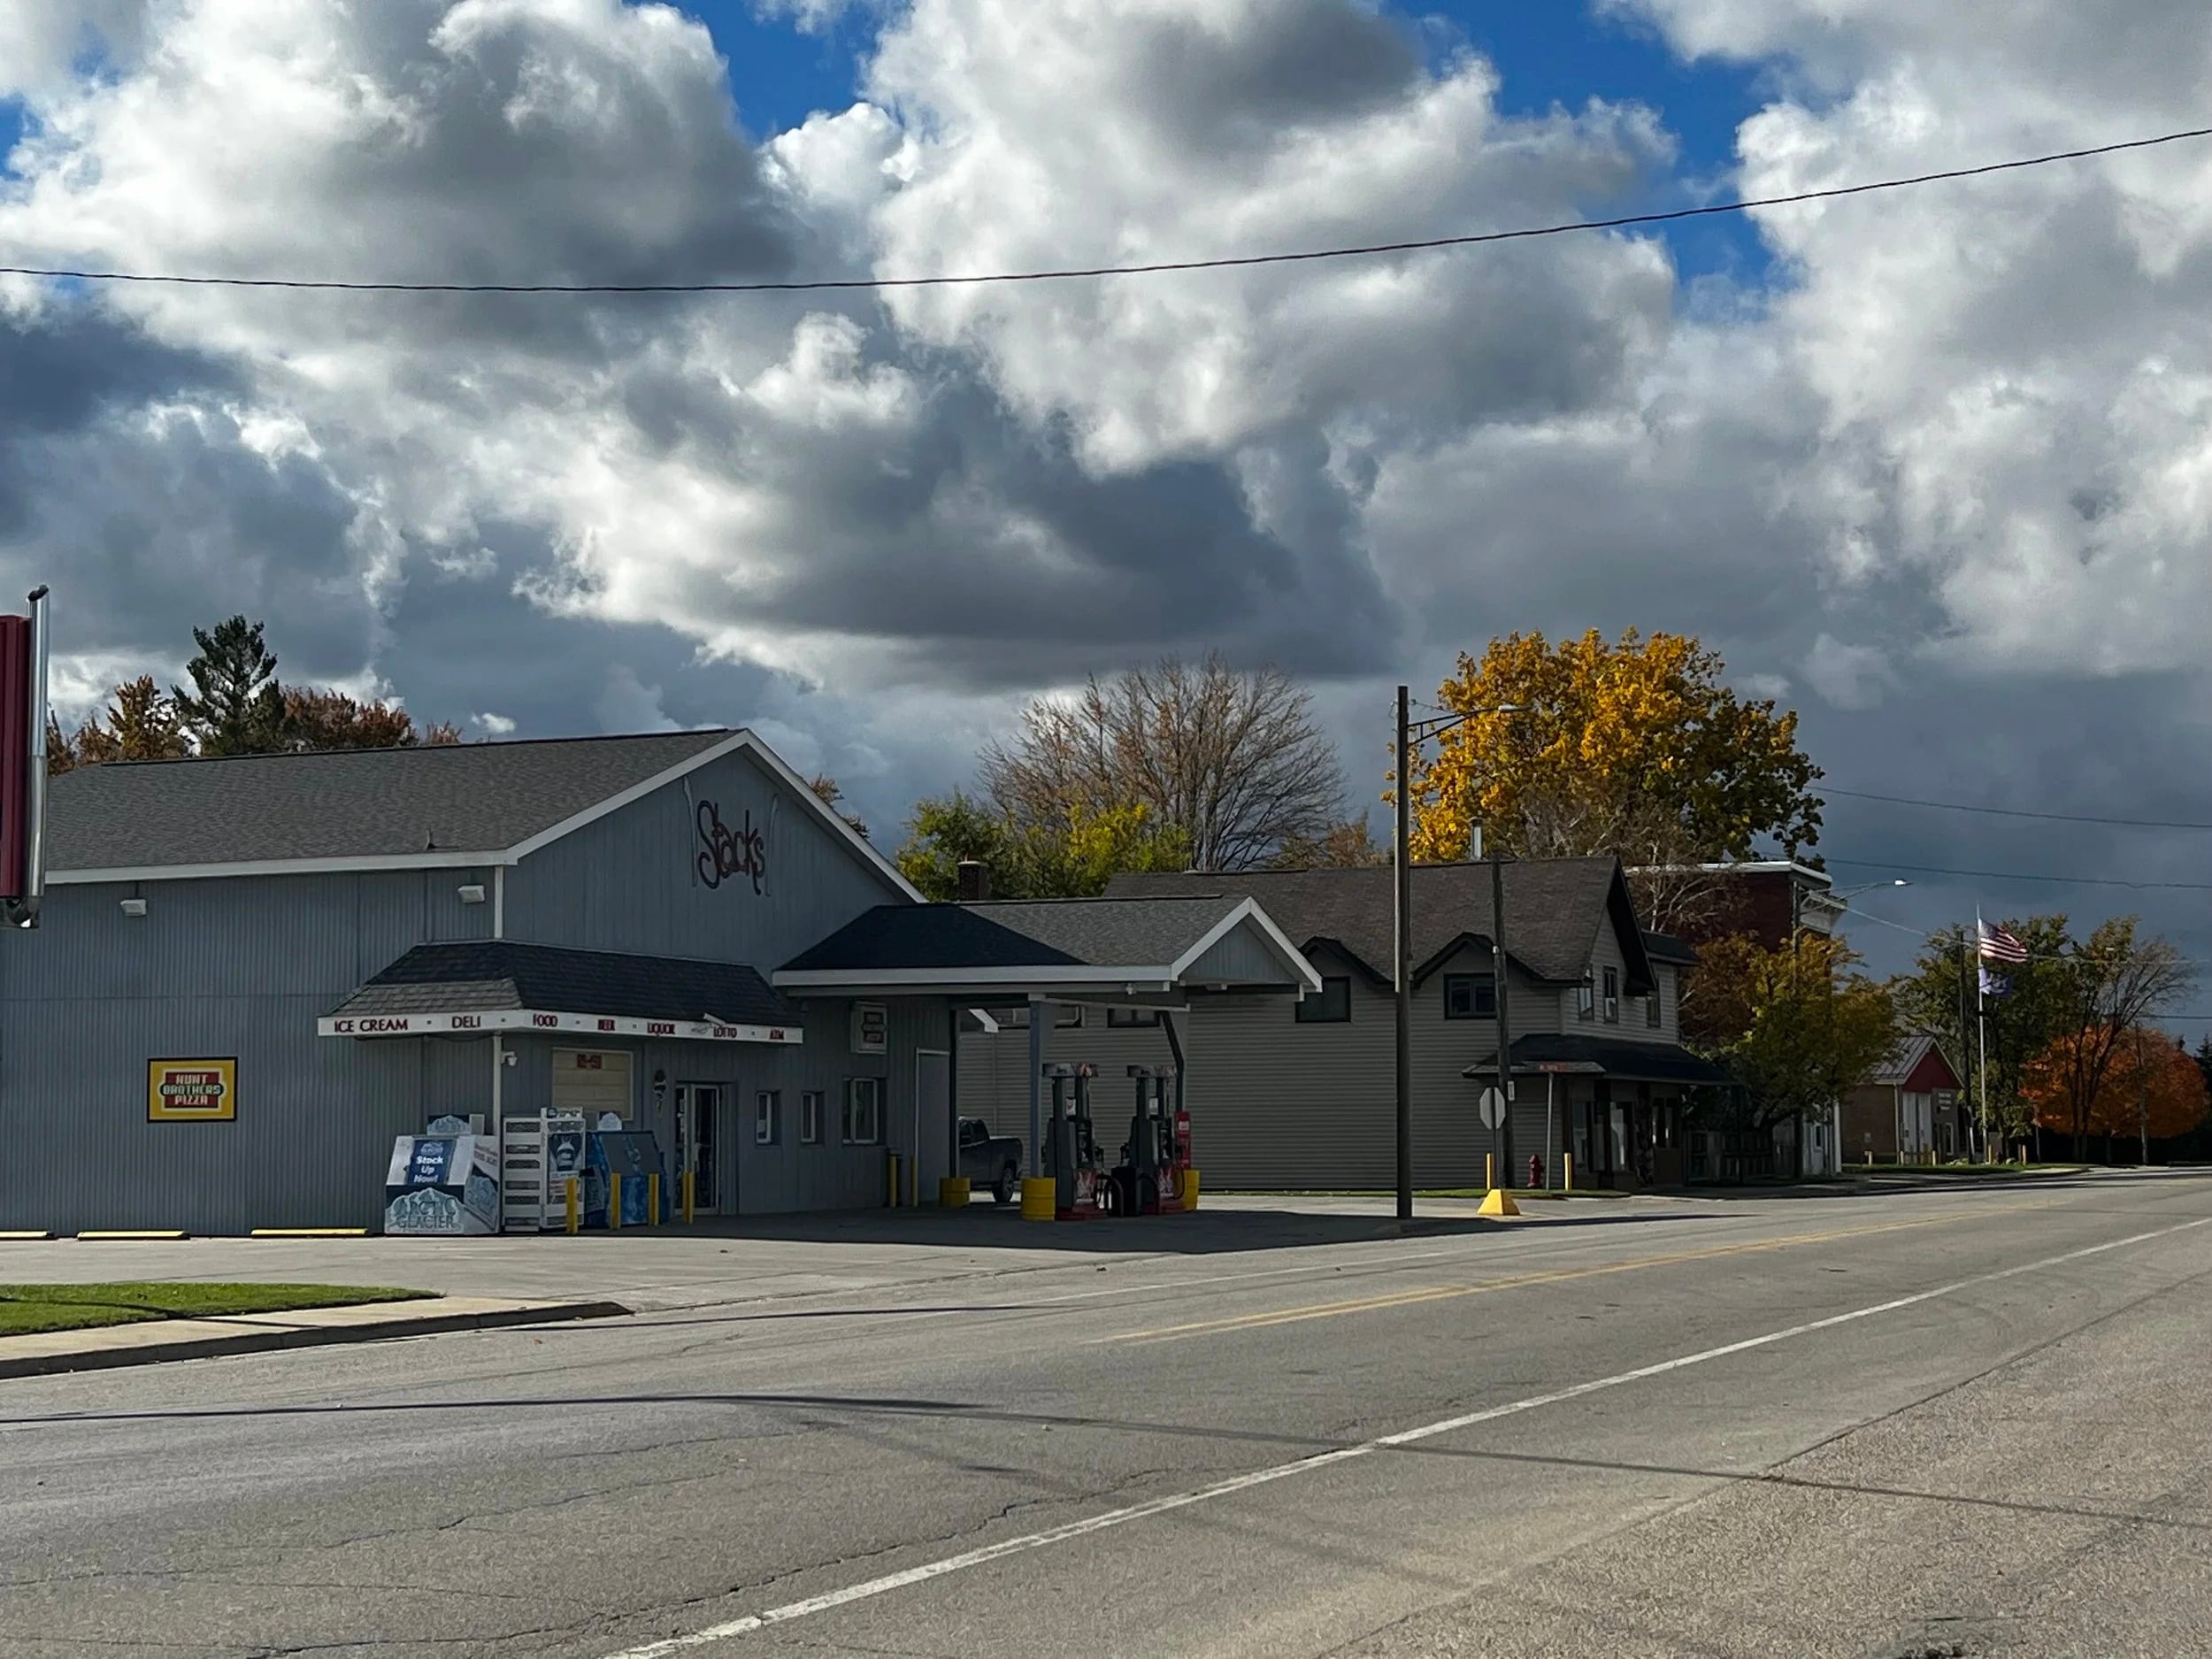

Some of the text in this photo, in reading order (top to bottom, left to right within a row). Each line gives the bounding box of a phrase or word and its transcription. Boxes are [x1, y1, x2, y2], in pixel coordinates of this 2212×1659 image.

[334, 1016, 481, 1033] ICE CREAM DELI
[533, 1013, 558, 1027] FOOD
[648, 1022, 675, 1034] LIQUOR
[713, 1025, 738, 1038] LOTTO
[175, 1073, 208, 1084] HUNT
[163, 1084, 221, 1095] BROTHERS
[174, 1095, 208, 1105] PIZZA
[416, 1156, 443, 1164] Stock
[421, 1165, 434, 1175] Up
[393, 1197, 457, 1216] ARCTIC
[396, 1215, 454, 1228] GLACIER
